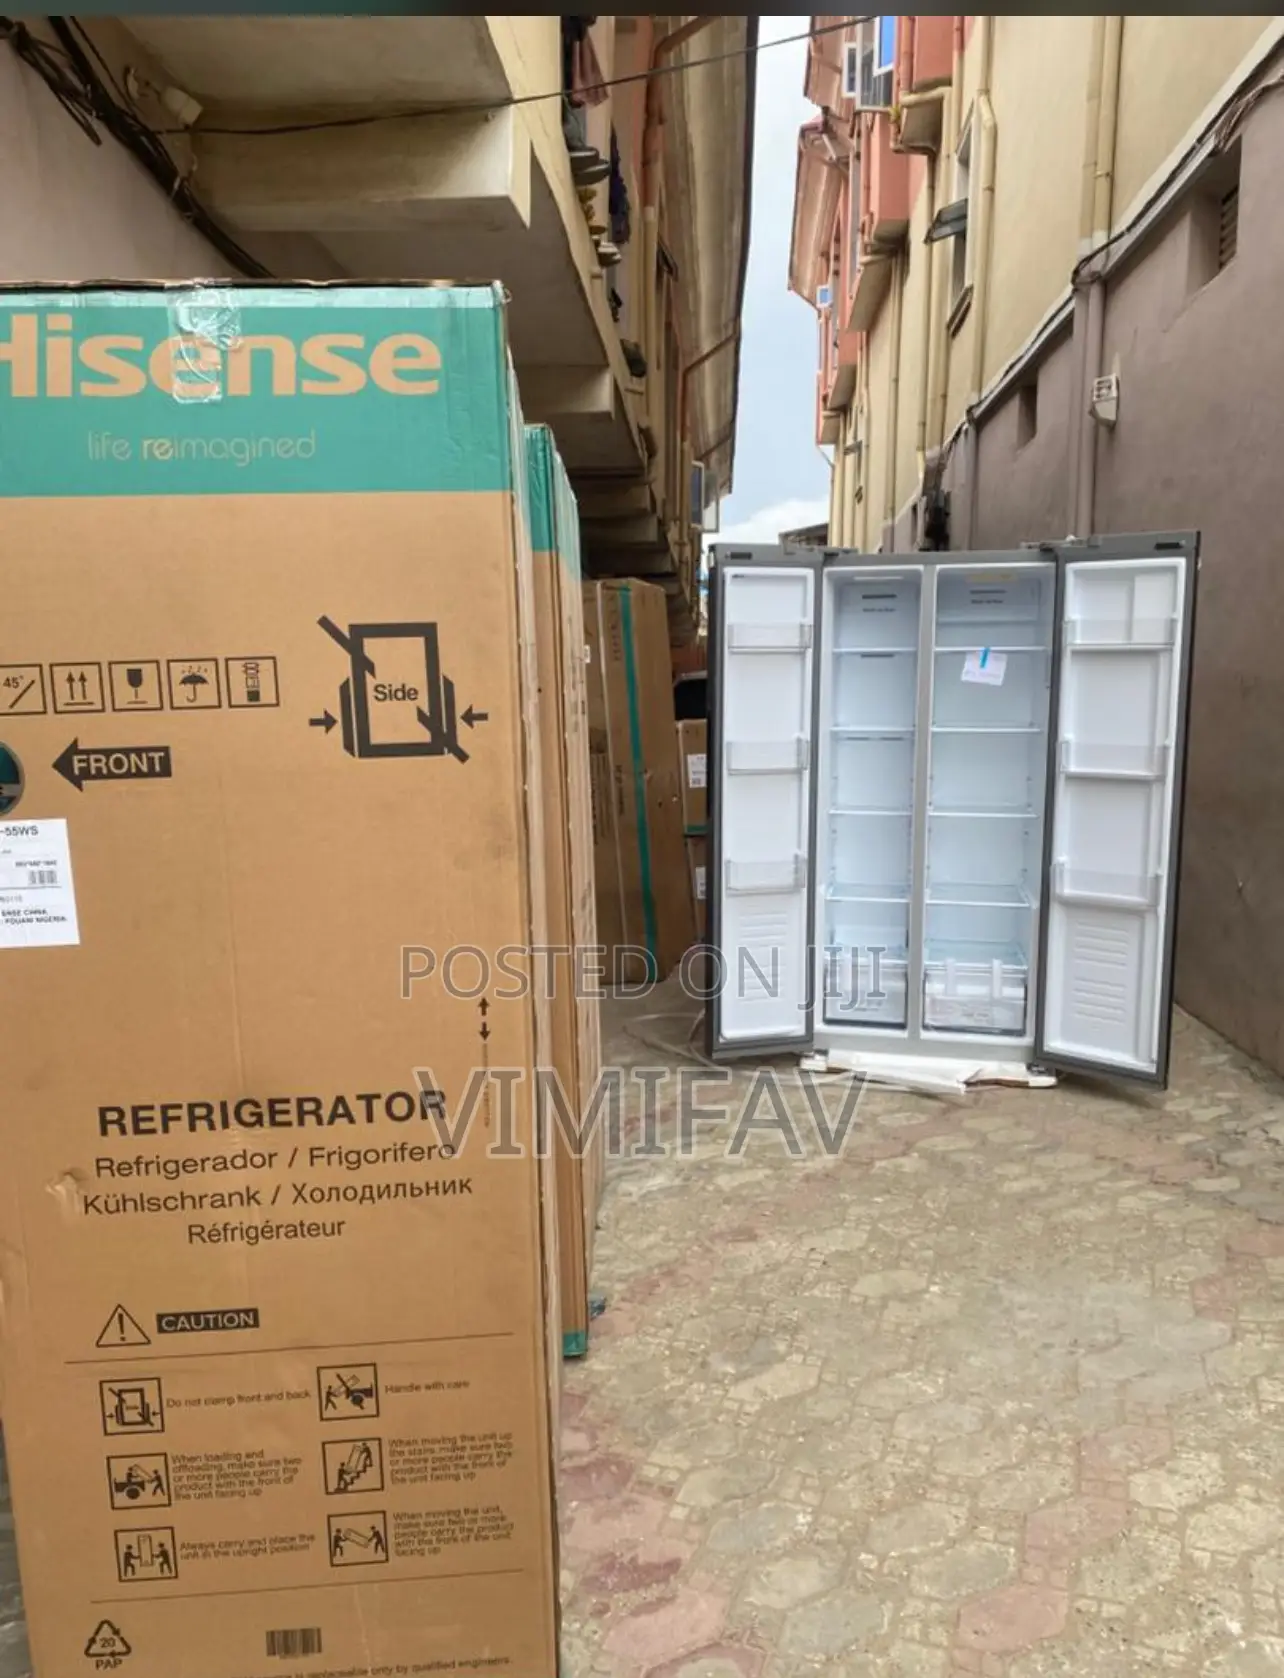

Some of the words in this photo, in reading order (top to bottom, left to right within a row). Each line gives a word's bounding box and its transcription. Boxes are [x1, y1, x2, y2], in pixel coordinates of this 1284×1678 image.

[0, 314, 441, 397] Hisense
[88, 431, 131, 460] life
[143, 430, 315, 466] reimagined
[374, 683, 419, 702] Side
[73, 750, 165, 776] FRONT
[97, 1090, 446, 1137] REFRIGERATOR
[95, 1149, 278, 1180] Refrigerador
[288, 1148, 298, 1168] /
[309, 1142, 456, 1170] Frigorifero
[83, 1187, 260, 1216] Kühlschrank
[271, 1186, 280, 1205] /
[291, 1178, 472, 1205] Холодильник
[188, 1218, 345, 1245] Réfrigérateur
[161, 1312, 254, 1331] CAUTION
[384, 1382, 421, 1394] Handle
[424, 1380, 444, 1391] with
[166, 1397, 181, 1408] Do
[184, 1397, 201, 1407] not
[264, 1391, 283, 1400] and
[286, 1389, 310, 1399] back
[389, 1437, 418, 1447] When
[171, 1454, 202, 1464] When
[245, 1449, 264, 1459] and
[393, 1511, 422, 1521] When
[99, 1637, 116, 1648] 20
[95, 1658, 122, 1670] PAP
